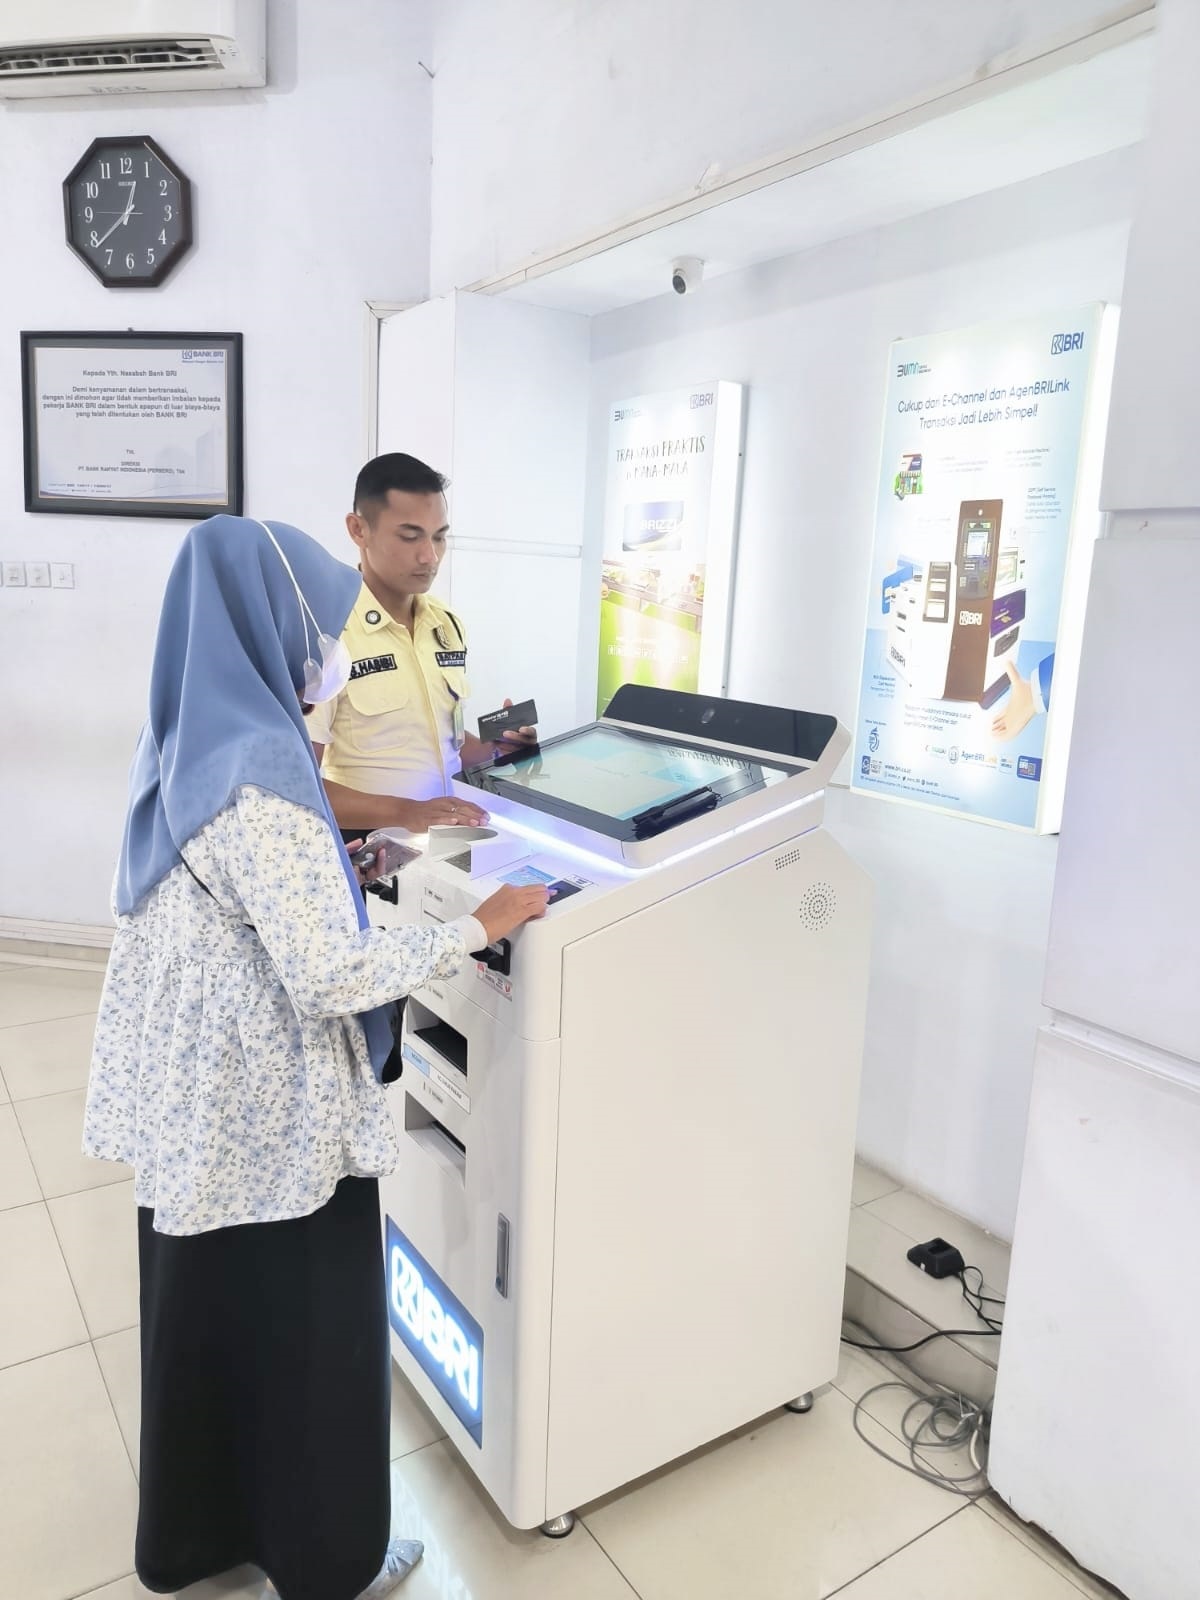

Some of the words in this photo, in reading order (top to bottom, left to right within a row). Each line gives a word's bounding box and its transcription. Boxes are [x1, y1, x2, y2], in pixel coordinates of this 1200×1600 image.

[100, 162, 111, 179] 11
[120, 157, 132, 174] 12
[144, 161, 150, 178] 1
[86, 181, 99, 198] 10
[159, 179, 168, 196] 2
[84, 206, 94, 223] 9
[163, 204, 173, 222] 3
[90, 230, 99, 248] 8
[158, 228, 167, 245] 4
[105, 249, 114, 265] 7
[126, 253, 135, 269] 6
[147, 248, 155, 264] 5
[1063, 332, 1084, 352] BRI
[700, 393, 714, 407] BRI
[897, 400, 923, 413] Cukup
[989, 387, 1007, 400] dan
[1009, 378, 1070, 398] AgenBRILink
[958, 410, 977, 426] Jadi
[979, 407, 1003, 423] Lebih
[661, 435, 706, 457] PRAKTIS
[422, 1287, 478, 1412] BRI
